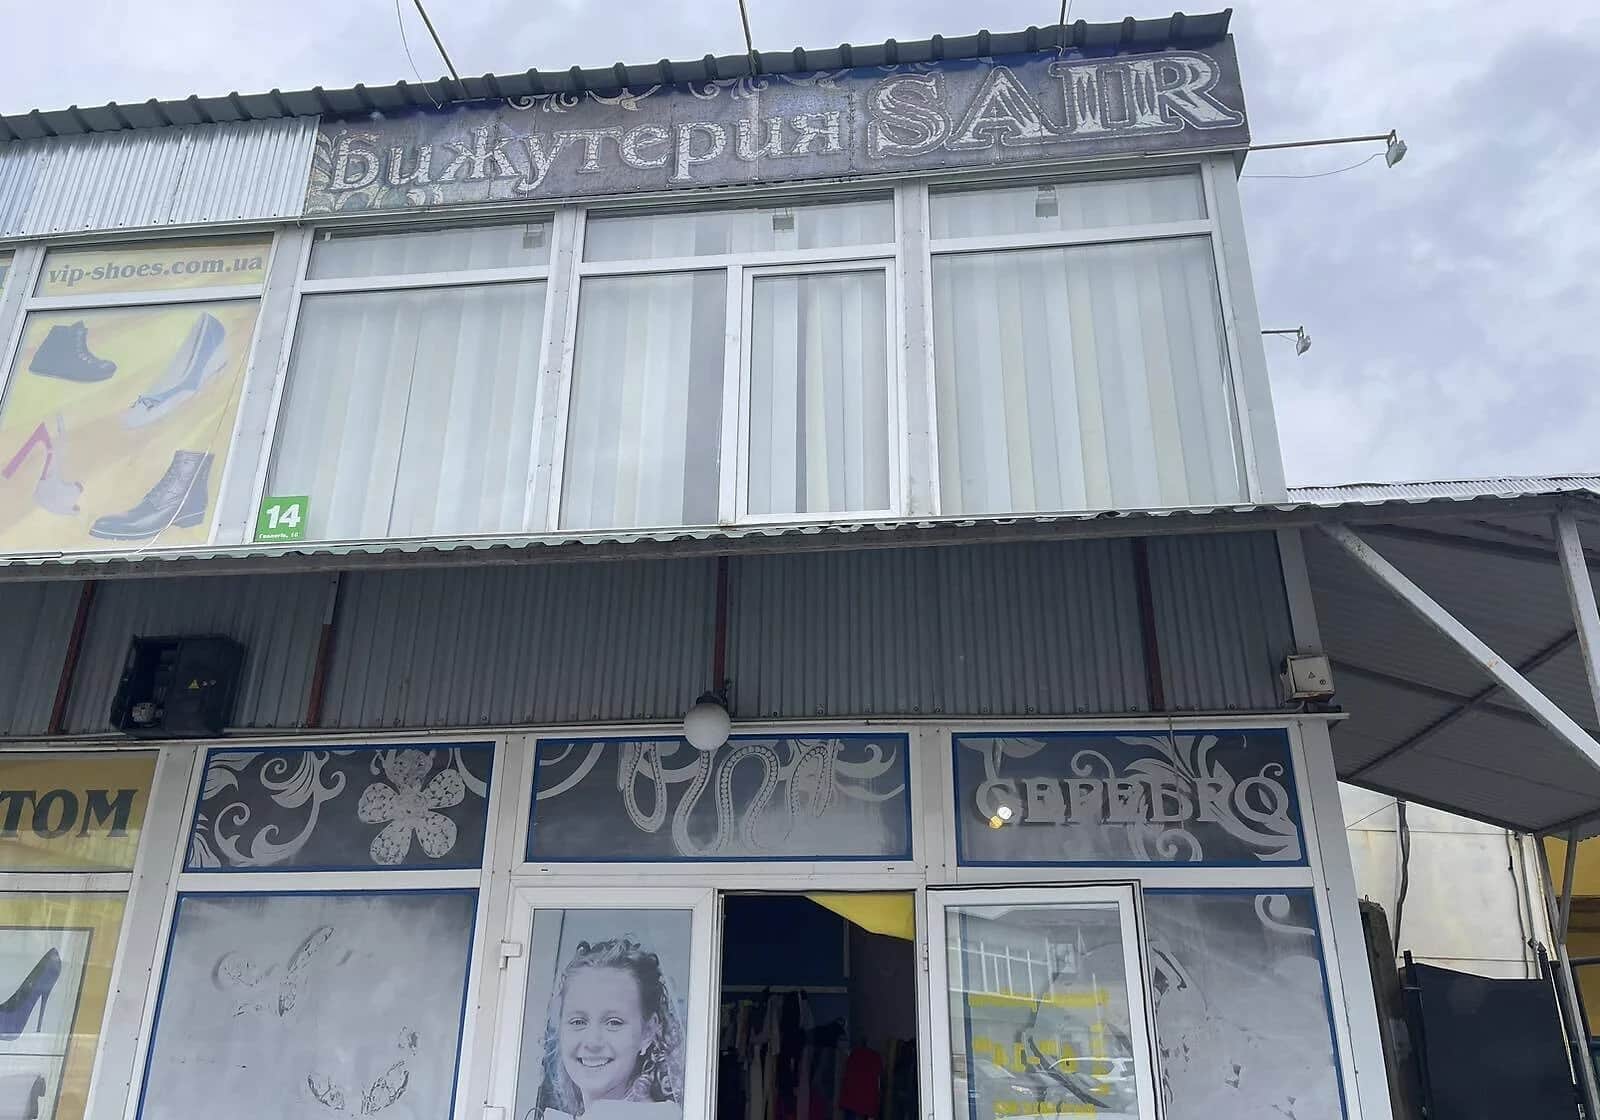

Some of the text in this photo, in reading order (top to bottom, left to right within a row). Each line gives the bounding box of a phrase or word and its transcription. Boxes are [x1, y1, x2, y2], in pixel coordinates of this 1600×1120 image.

[330, 110, 842, 190] Бижутерия
[50, 255, 263, 287] vip-shoes.com.ua
[266, 503, 301, 529] 14
